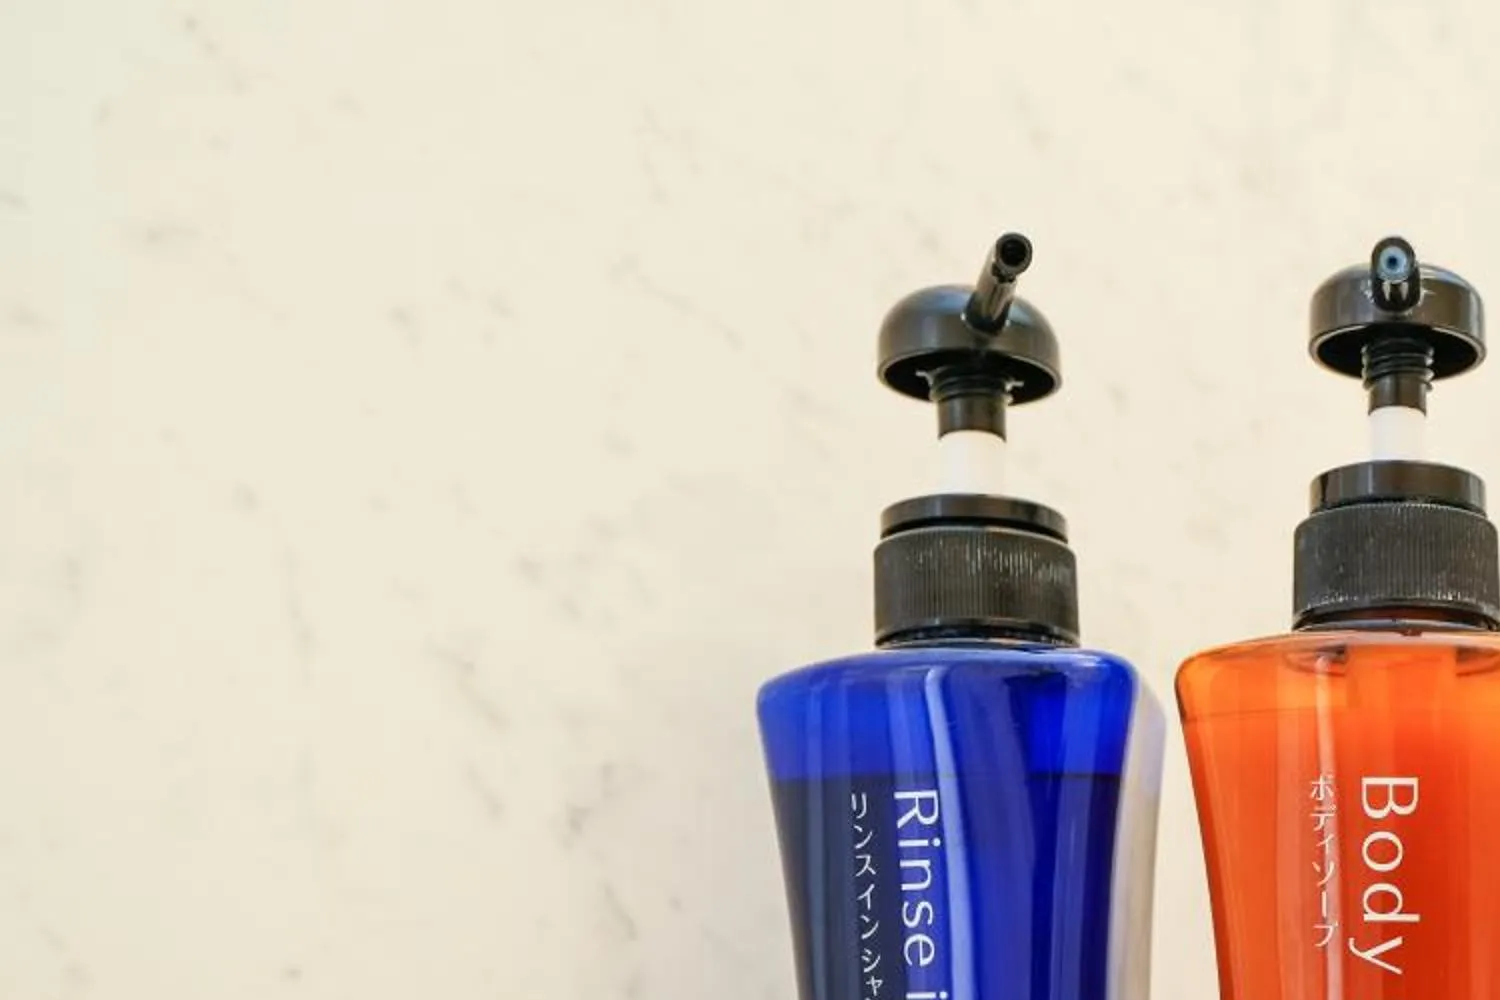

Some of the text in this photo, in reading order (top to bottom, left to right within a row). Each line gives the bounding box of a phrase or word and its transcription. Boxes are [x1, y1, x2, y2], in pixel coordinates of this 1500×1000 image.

[893, 788, 941, 967] Rinse
[1310, 774, 1339, 948] ボディソープ
[1349, 776, 1420, 975] Body
